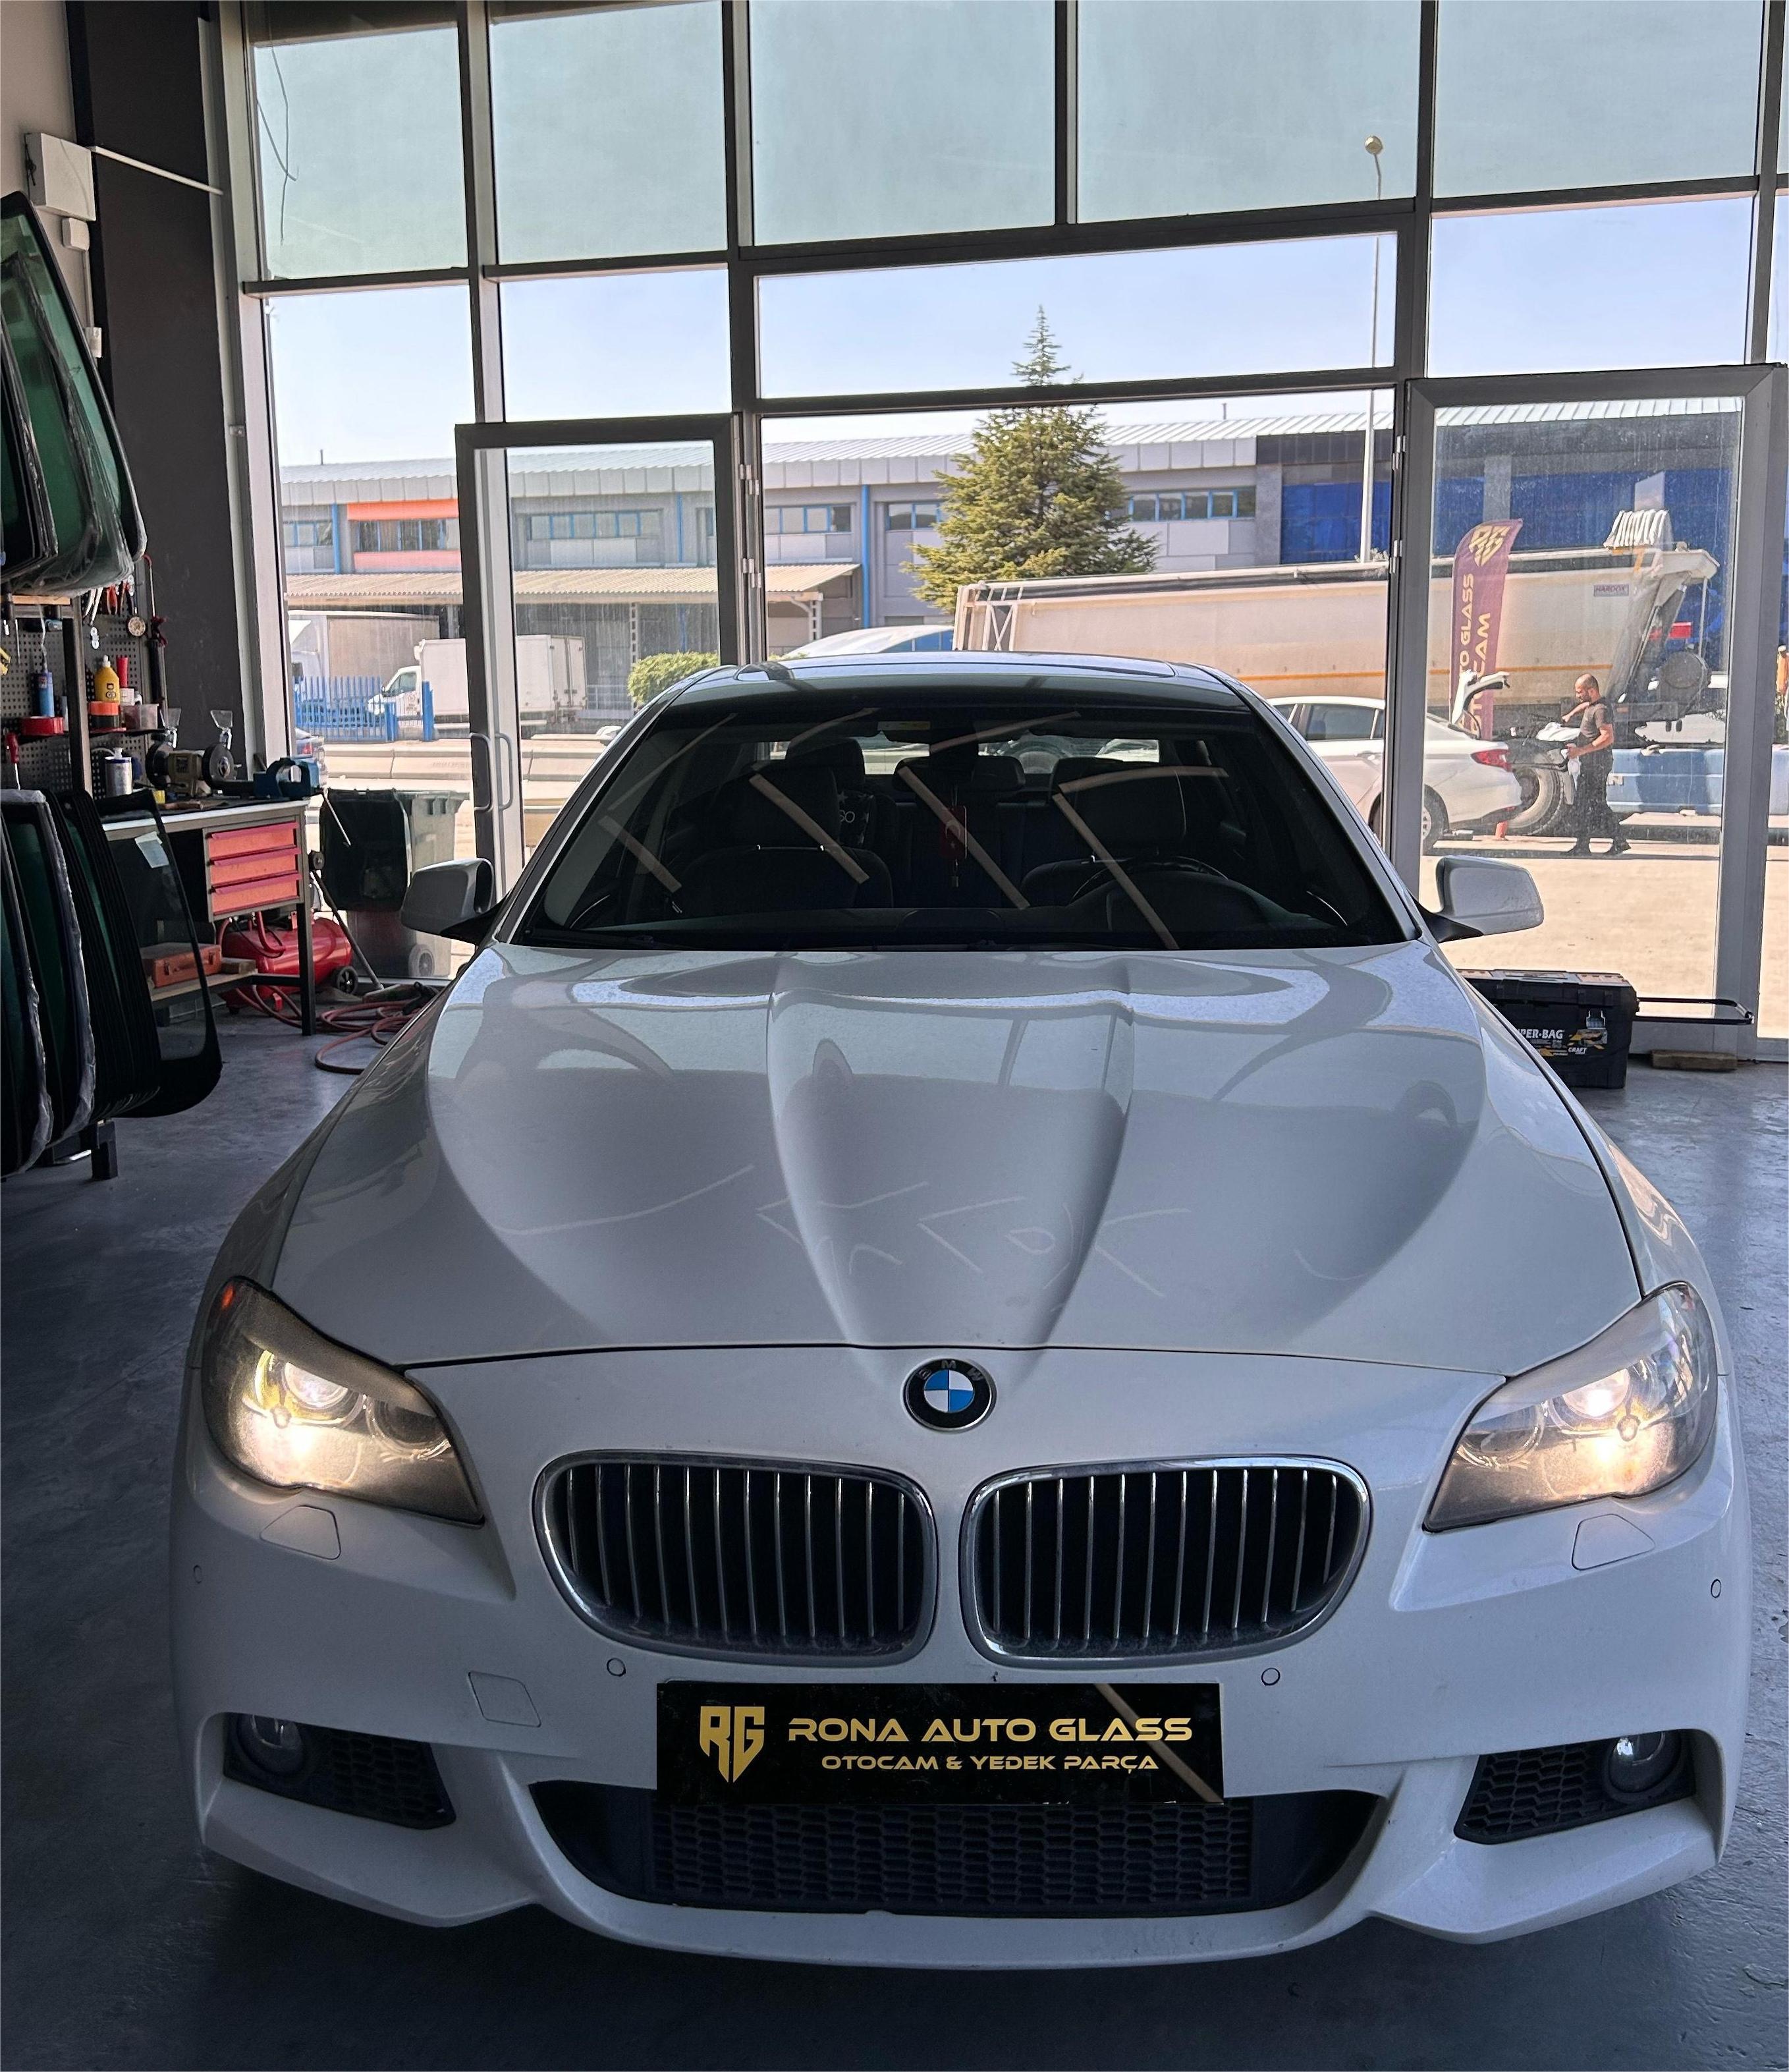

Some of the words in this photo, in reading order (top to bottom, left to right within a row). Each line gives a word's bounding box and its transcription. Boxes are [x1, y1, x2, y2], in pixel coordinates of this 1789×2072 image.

[1460, 573, 1474, 646] GLASS
[918, 1359, 985, 1381] BMW
[788, 1718, 909, 1742] RONA
[921, 1718, 1036, 1741] AUTO
[1049, 1717, 1193, 1741] GLASS
[700, 1706, 765, 1783] RG
[821, 1755, 939, 1770] OTOCAM
[946, 1756, 962, 1770] &
[970, 1756, 1056, 1770] YEDEK
[1064, 1755, 1159, 1774] PARÇA
